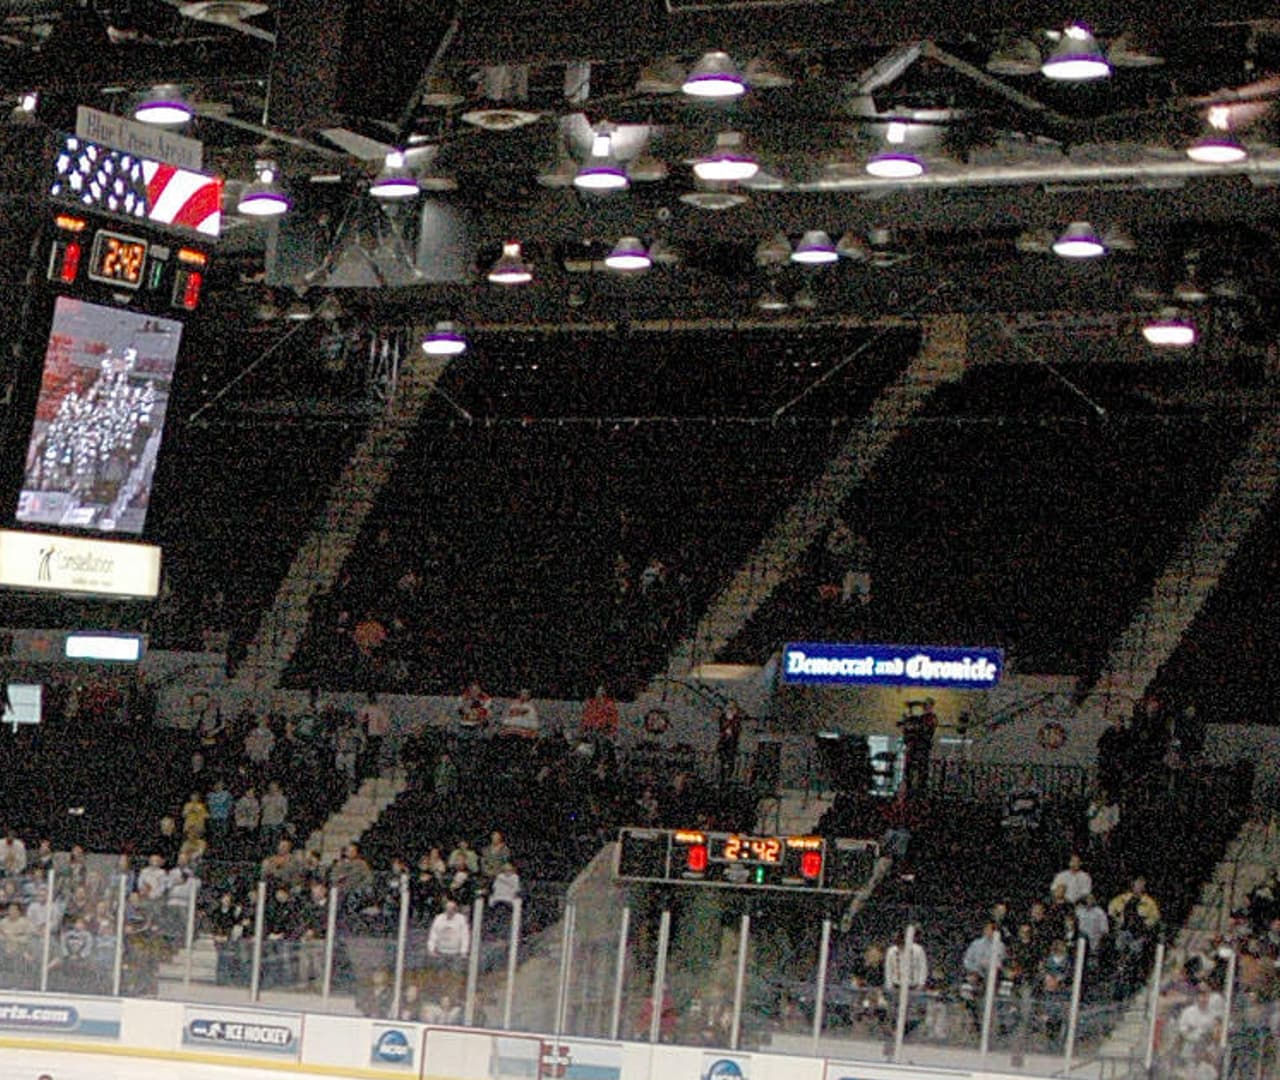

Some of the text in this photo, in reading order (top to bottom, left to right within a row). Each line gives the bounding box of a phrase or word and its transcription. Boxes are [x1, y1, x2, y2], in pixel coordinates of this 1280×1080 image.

[787, 651, 997, 681] Democrat and Chronicle
[725, 836, 781, 863] 2:42
[225, 1024, 290, 1045] ICE HOCKEY
